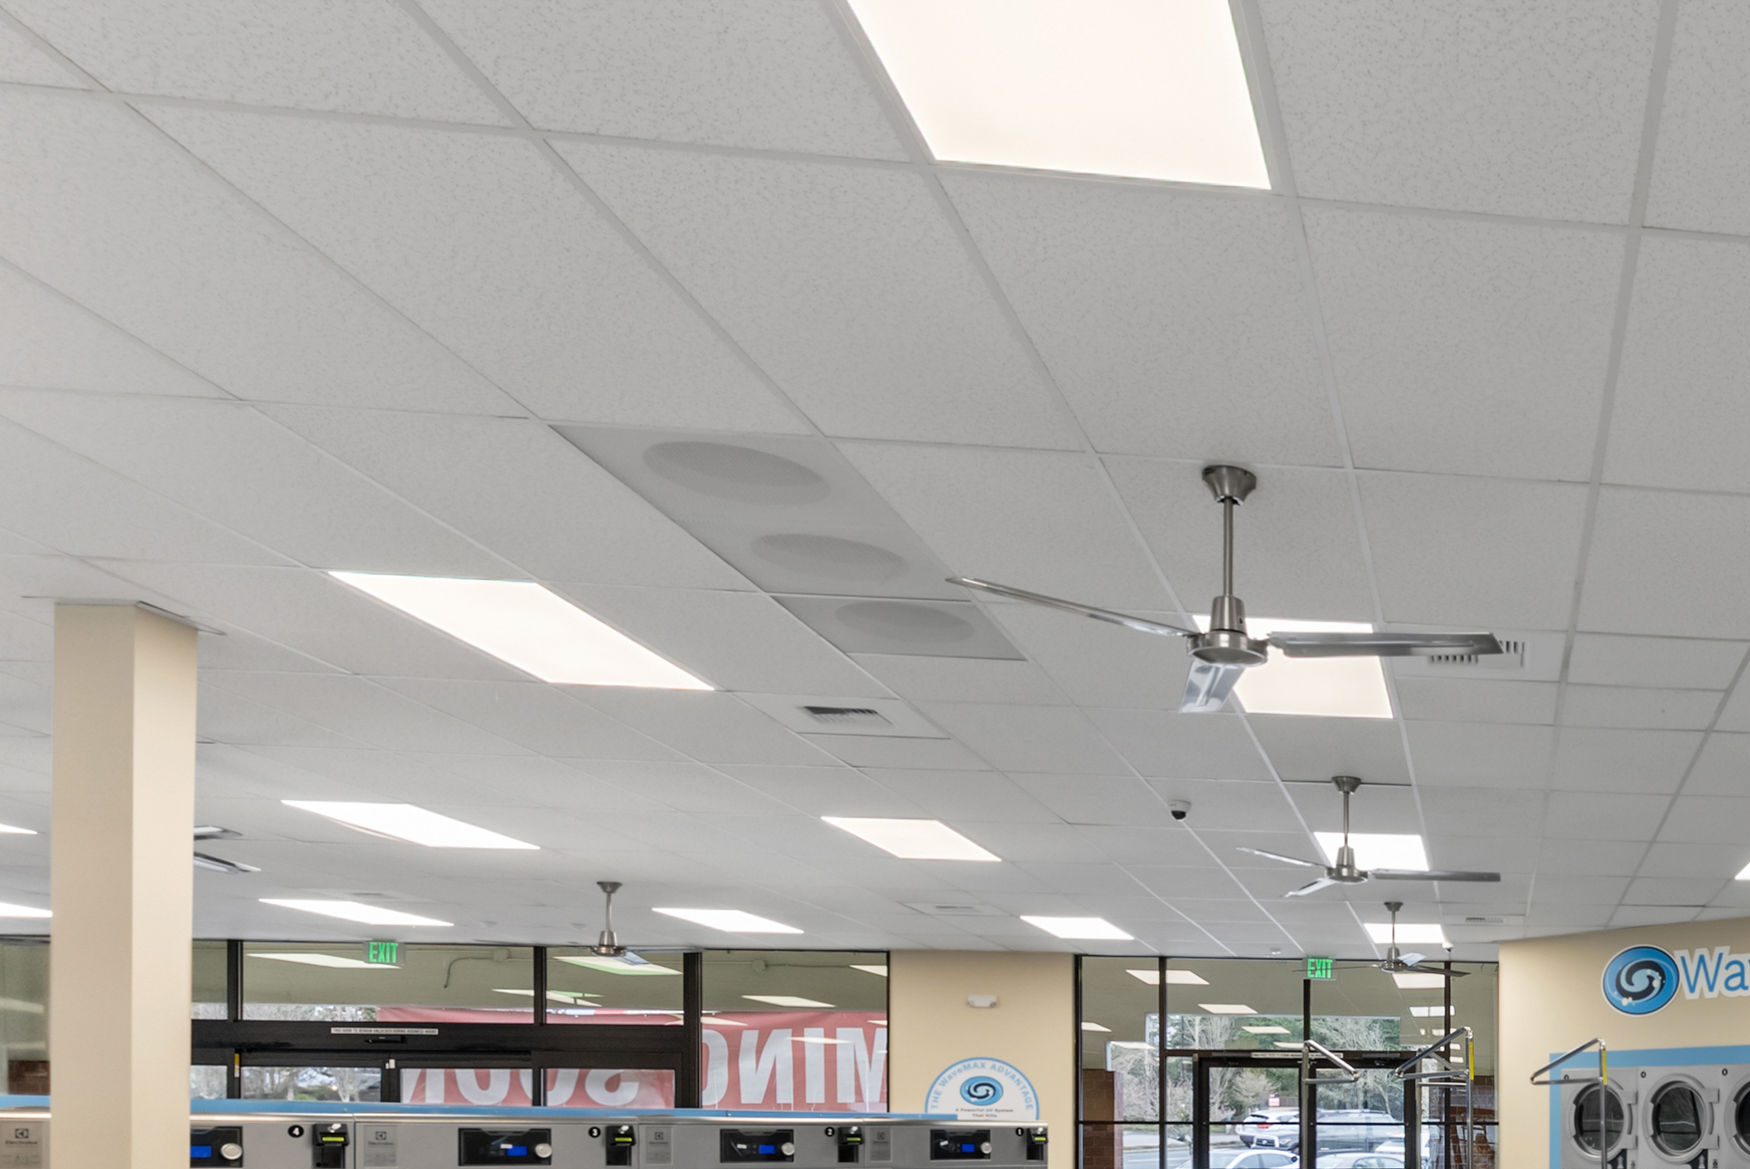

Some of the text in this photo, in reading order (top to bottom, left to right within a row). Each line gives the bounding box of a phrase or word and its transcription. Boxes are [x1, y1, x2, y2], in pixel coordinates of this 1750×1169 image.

[369, 942, 398, 963] EXIT
[1307, 958, 1333, 979] EXIT
[990, 1063, 1034, 1110] ADVANTAGE
